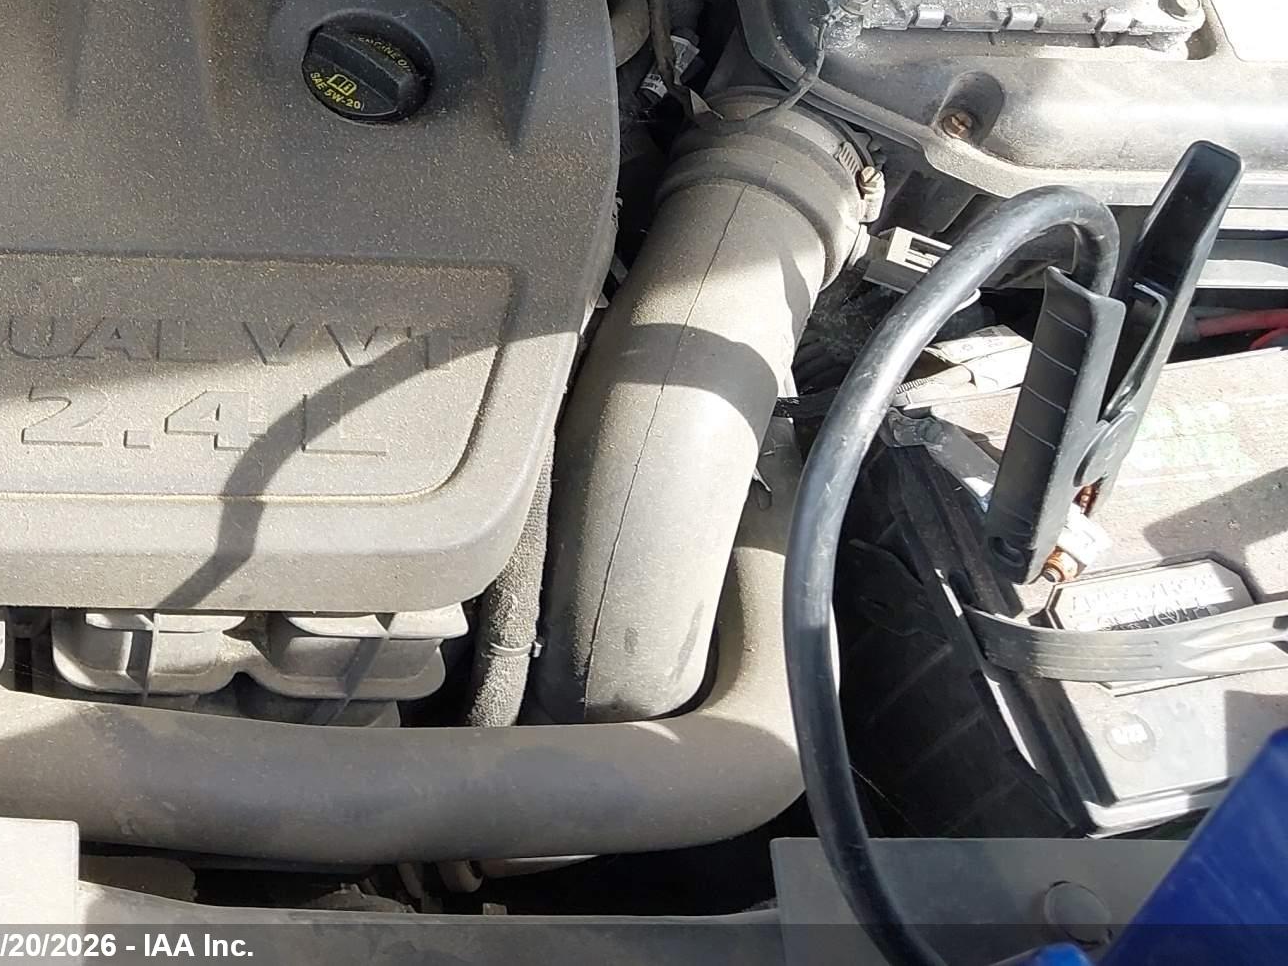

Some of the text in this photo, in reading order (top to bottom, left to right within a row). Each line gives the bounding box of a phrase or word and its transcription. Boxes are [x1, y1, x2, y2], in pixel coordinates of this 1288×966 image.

[310, 72, 361, 110] SAE 5W-20
[242, 318, 473, 371] VVT
